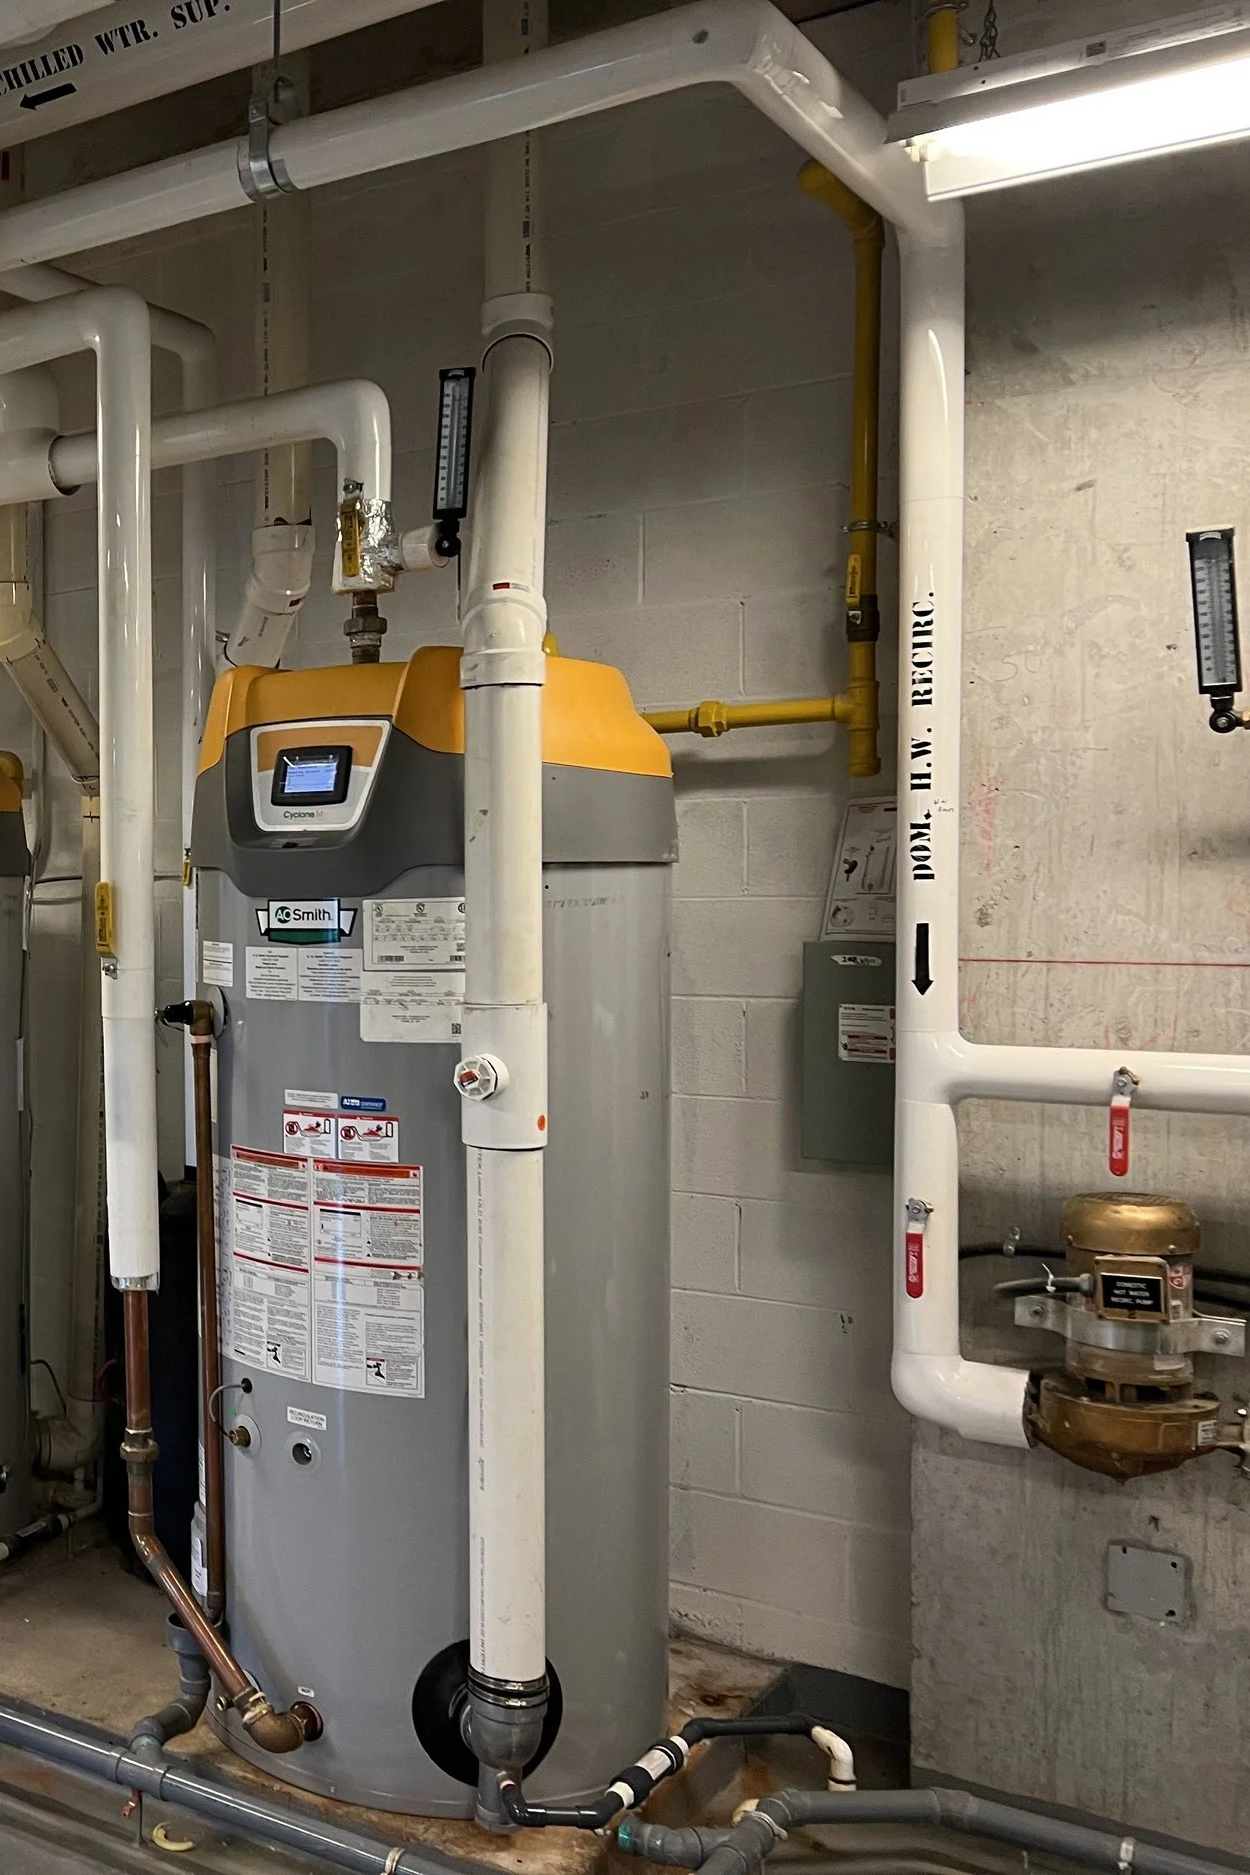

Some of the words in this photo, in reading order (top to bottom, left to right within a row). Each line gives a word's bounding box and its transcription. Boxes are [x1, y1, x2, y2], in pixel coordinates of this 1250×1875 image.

[94, 18, 159, 56] WTR.
[170, 0, 232, 30] SUP.
[911, 591, 935, 707] RECIRC.
[910, 727, 933, 791] H.W.
[283, 810, 315, 819] Cyclone
[910, 809, 936, 881] DOM.
[292, 908, 331, 921] Smith
